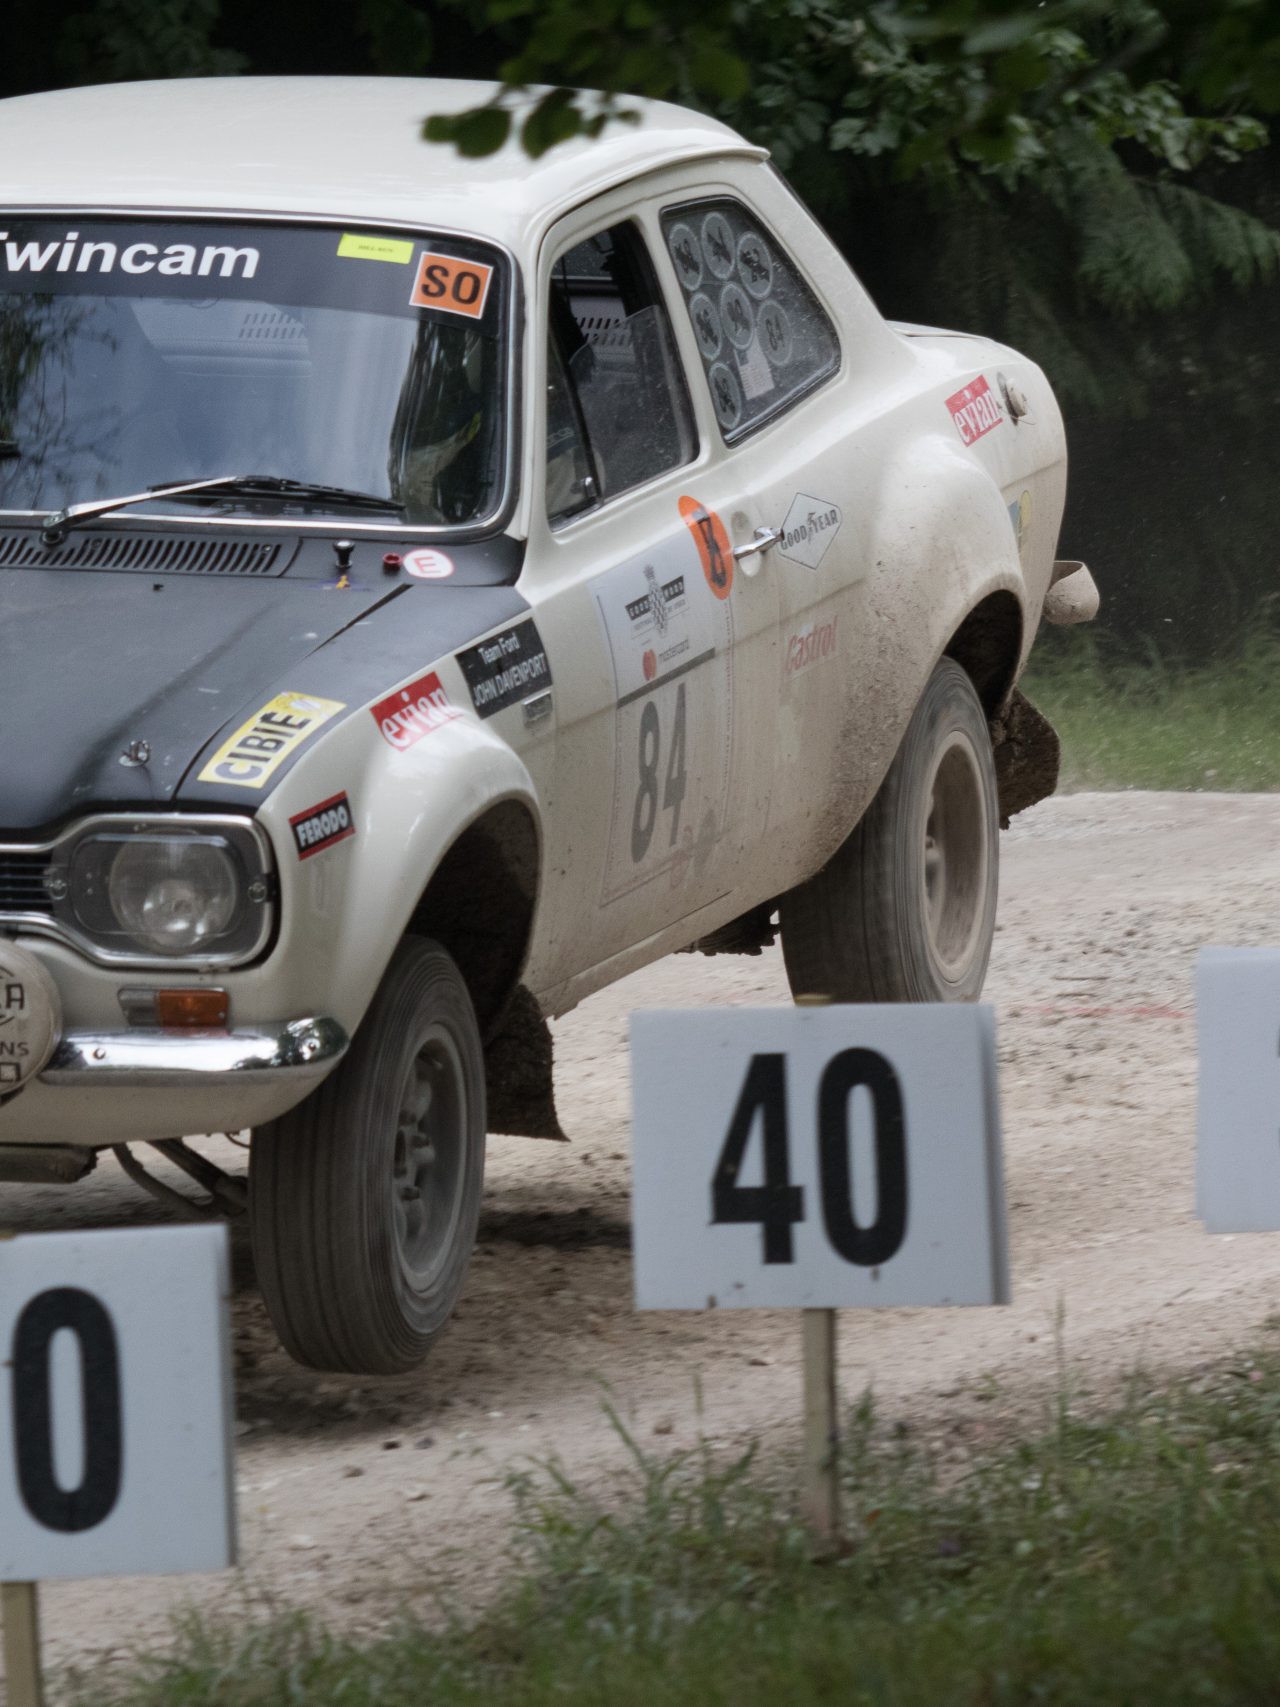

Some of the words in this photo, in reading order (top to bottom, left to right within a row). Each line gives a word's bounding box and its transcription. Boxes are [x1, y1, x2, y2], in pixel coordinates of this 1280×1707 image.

[421, 265, 481, 305] SO
[953, 389, 1001, 443] evian
[414, 556, 441, 574] E
[477, 645, 503, 665] Team
[498, 632, 520, 655] Ford
[785, 615, 838, 677] Castrol
[473, 678, 498, 706] JOHN
[494, 652, 547, 695] DAVENPORT
[381, 687, 458, 748] evian
[631, 682, 687, 863] 84
[296, 804, 348, 848] FERODO
[710, 1046, 909, 1266] 40
